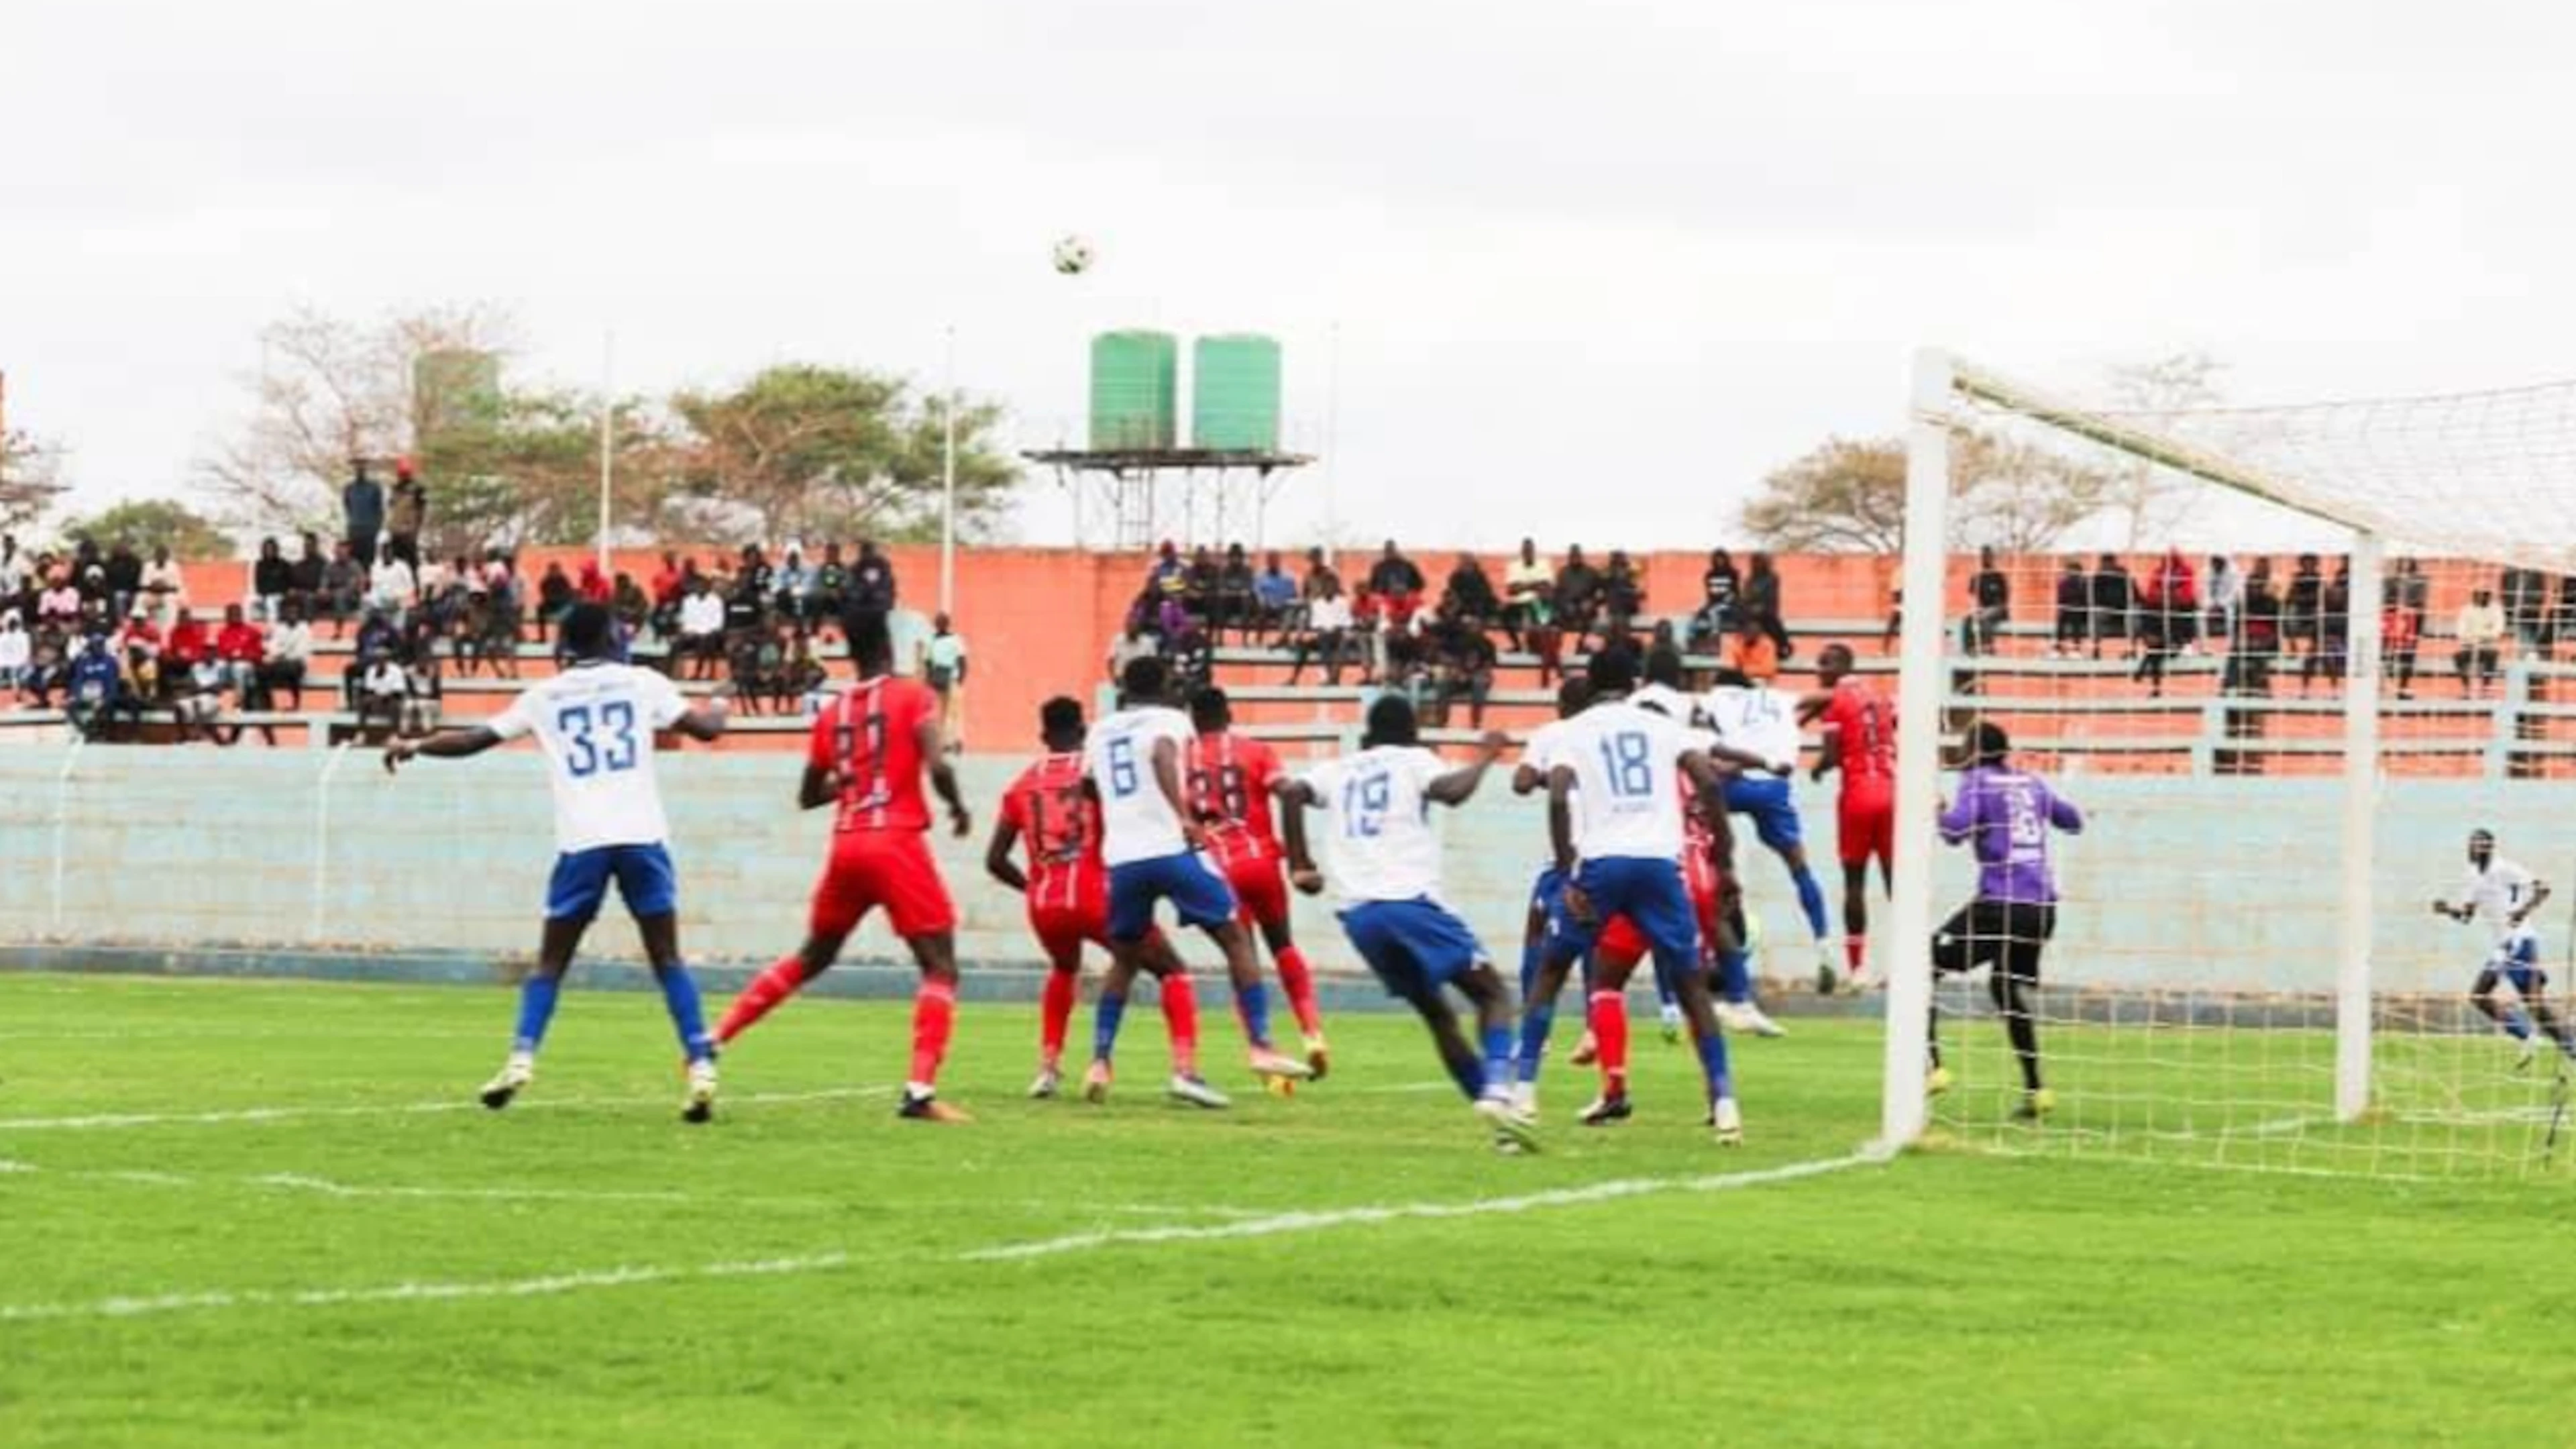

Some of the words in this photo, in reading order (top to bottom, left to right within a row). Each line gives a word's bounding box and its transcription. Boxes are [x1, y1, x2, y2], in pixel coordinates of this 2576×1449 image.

[558, 700, 636, 778] 33
[1108, 736, 1137, 797] 6
[1601, 730, 1653, 797] 18
[1343, 770, 1390, 838] 19
